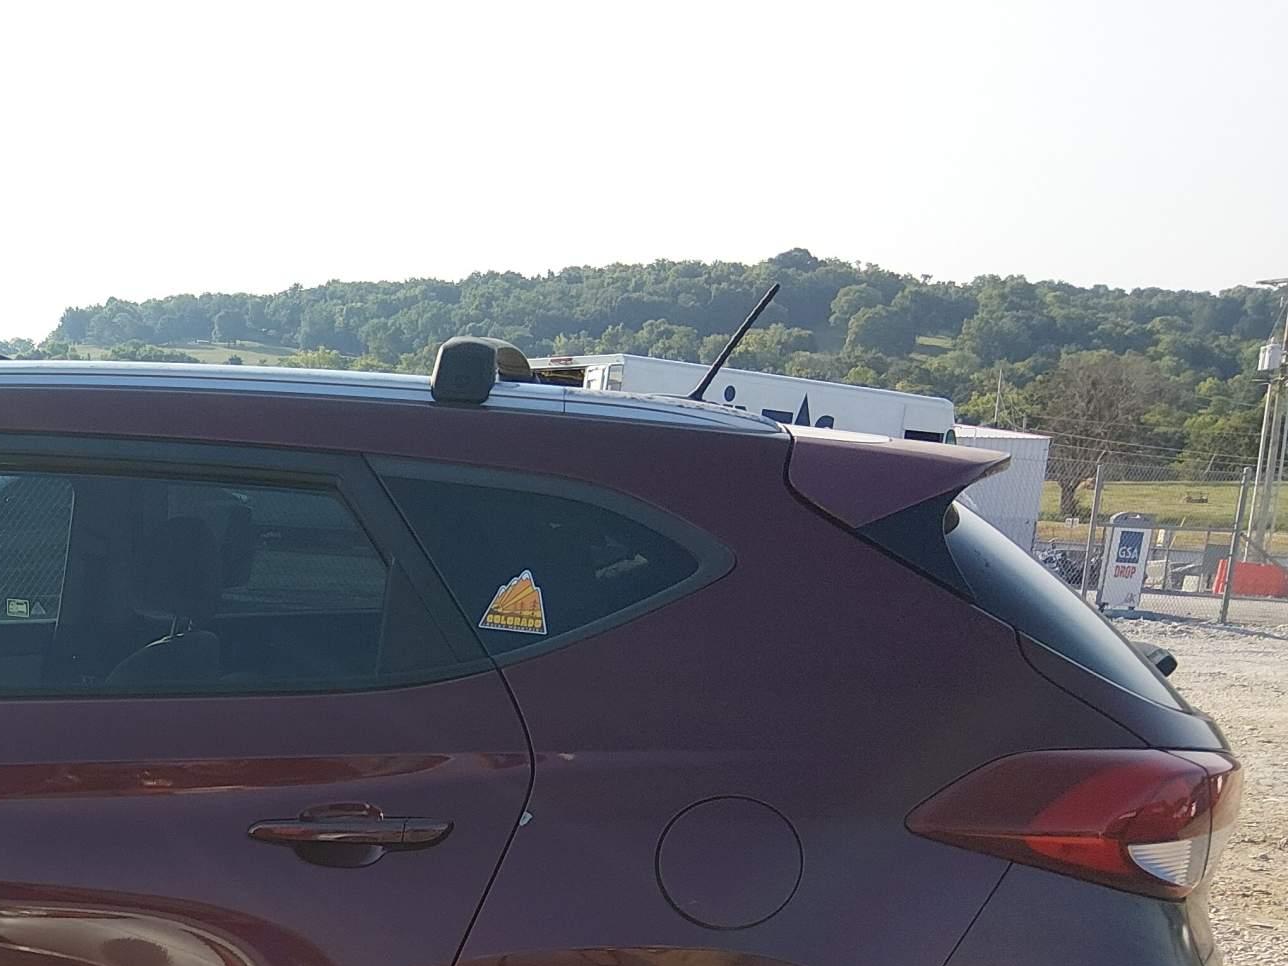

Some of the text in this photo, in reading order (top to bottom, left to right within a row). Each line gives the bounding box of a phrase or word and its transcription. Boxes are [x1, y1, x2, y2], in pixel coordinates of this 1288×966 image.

[1119, 546, 1138, 559] GSA
[1114, 565, 1136, 578] DROP
[487, 614, 541, 628] COLORADO
